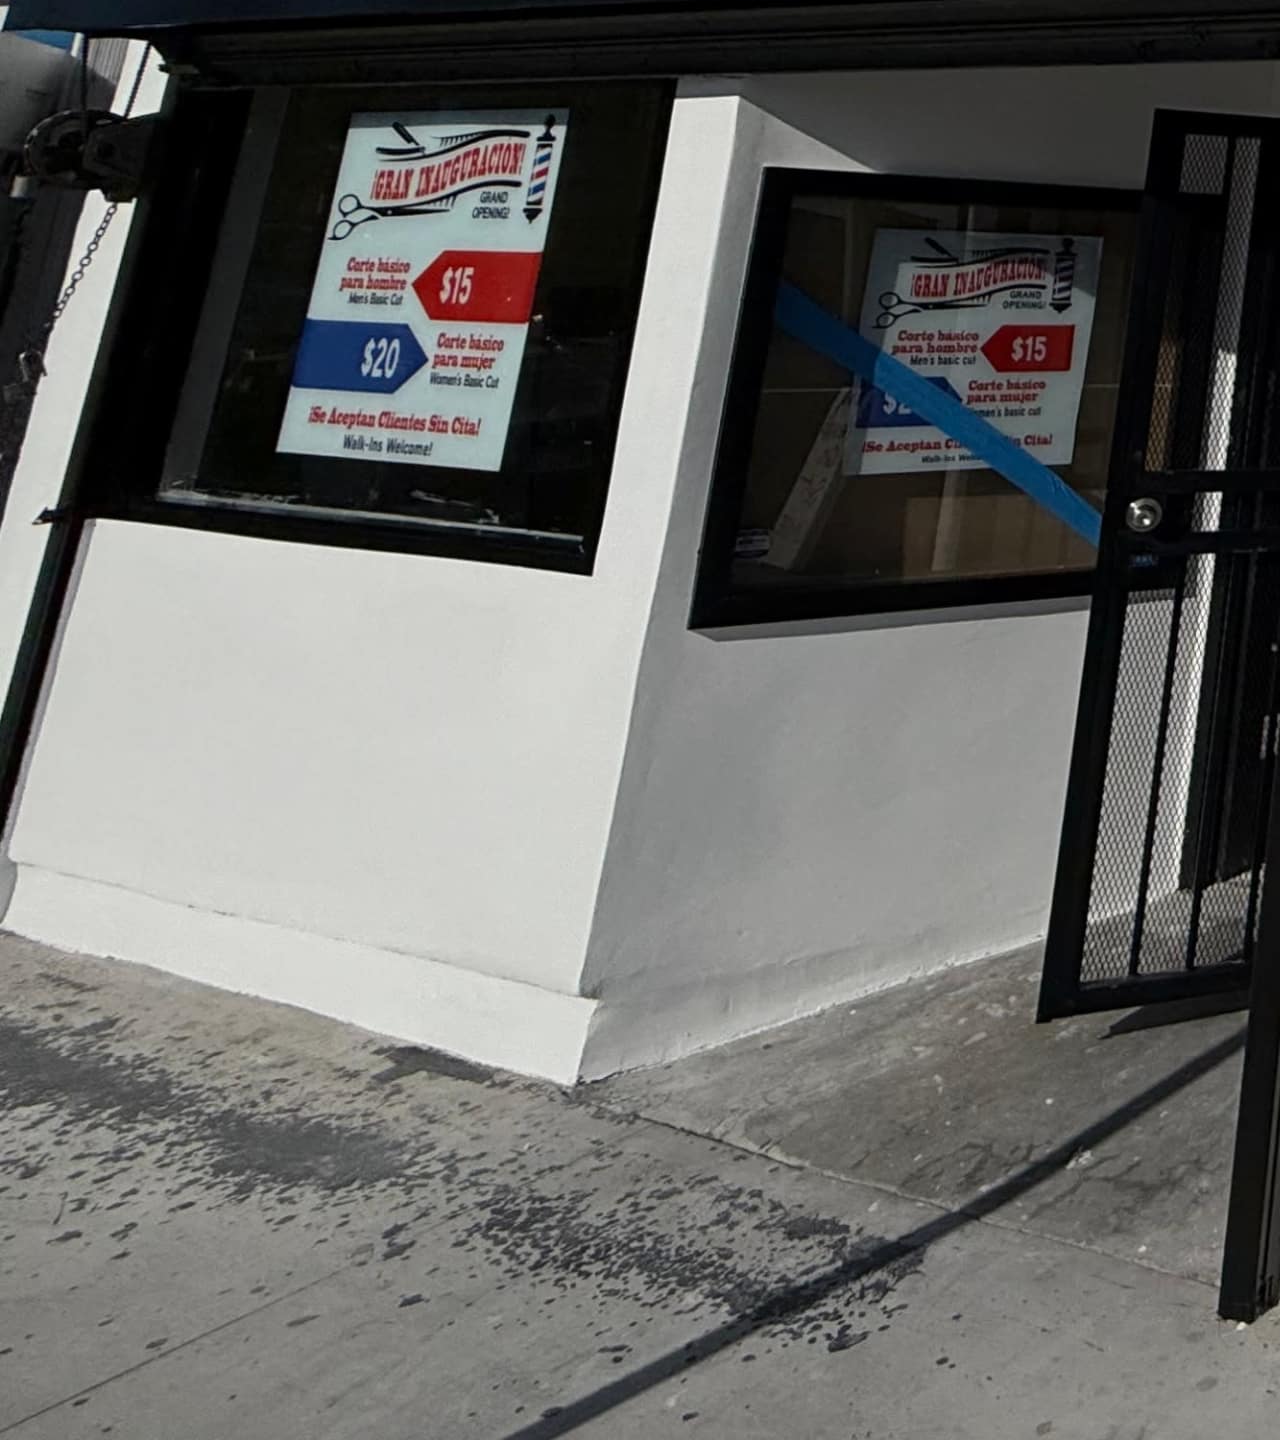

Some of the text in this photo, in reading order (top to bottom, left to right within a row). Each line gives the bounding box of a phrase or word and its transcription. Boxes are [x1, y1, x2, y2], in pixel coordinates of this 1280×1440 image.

[480, 191, 509, 203] GRAND
[347, 257, 411, 274] Corte básico
[339, 275, 407, 292] para hombre
[439, 267, 474, 304] $15
[348, 293, 403, 306] Men's Basic Cut
[1009, 290, 1042, 300] GRAND
[437, 332, 504, 351] Corte básico
[897, 329, 934, 342] Corte
[892, 342, 978, 355] para hombre
[1011, 335, 1047, 363] $15
[361, 337, 400, 378] $20
[432, 353, 496, 371] para mujer
[910, 355, 936, 366] Men's
[430, 372, 499, 389] Women's Basic Cut
[968, 379, 1004, 392] Corte
[882, 388, 914, 415] $2
[967, 392, 1039, 405] para mujer
[1004, 406, 1026, 417] basic
[327, 408, 375, 429] Aceptan
[378, 411, 427, 432] Clientes
[428, 415, 449, 433] Sin
[451, 417, 482, 436] Cita!
[343, 435, 433, 457] Walk-Ins Welcome!
[885, 439, 942, 453] Aceptan
[1024, 434, 1053, 447] Cita!
